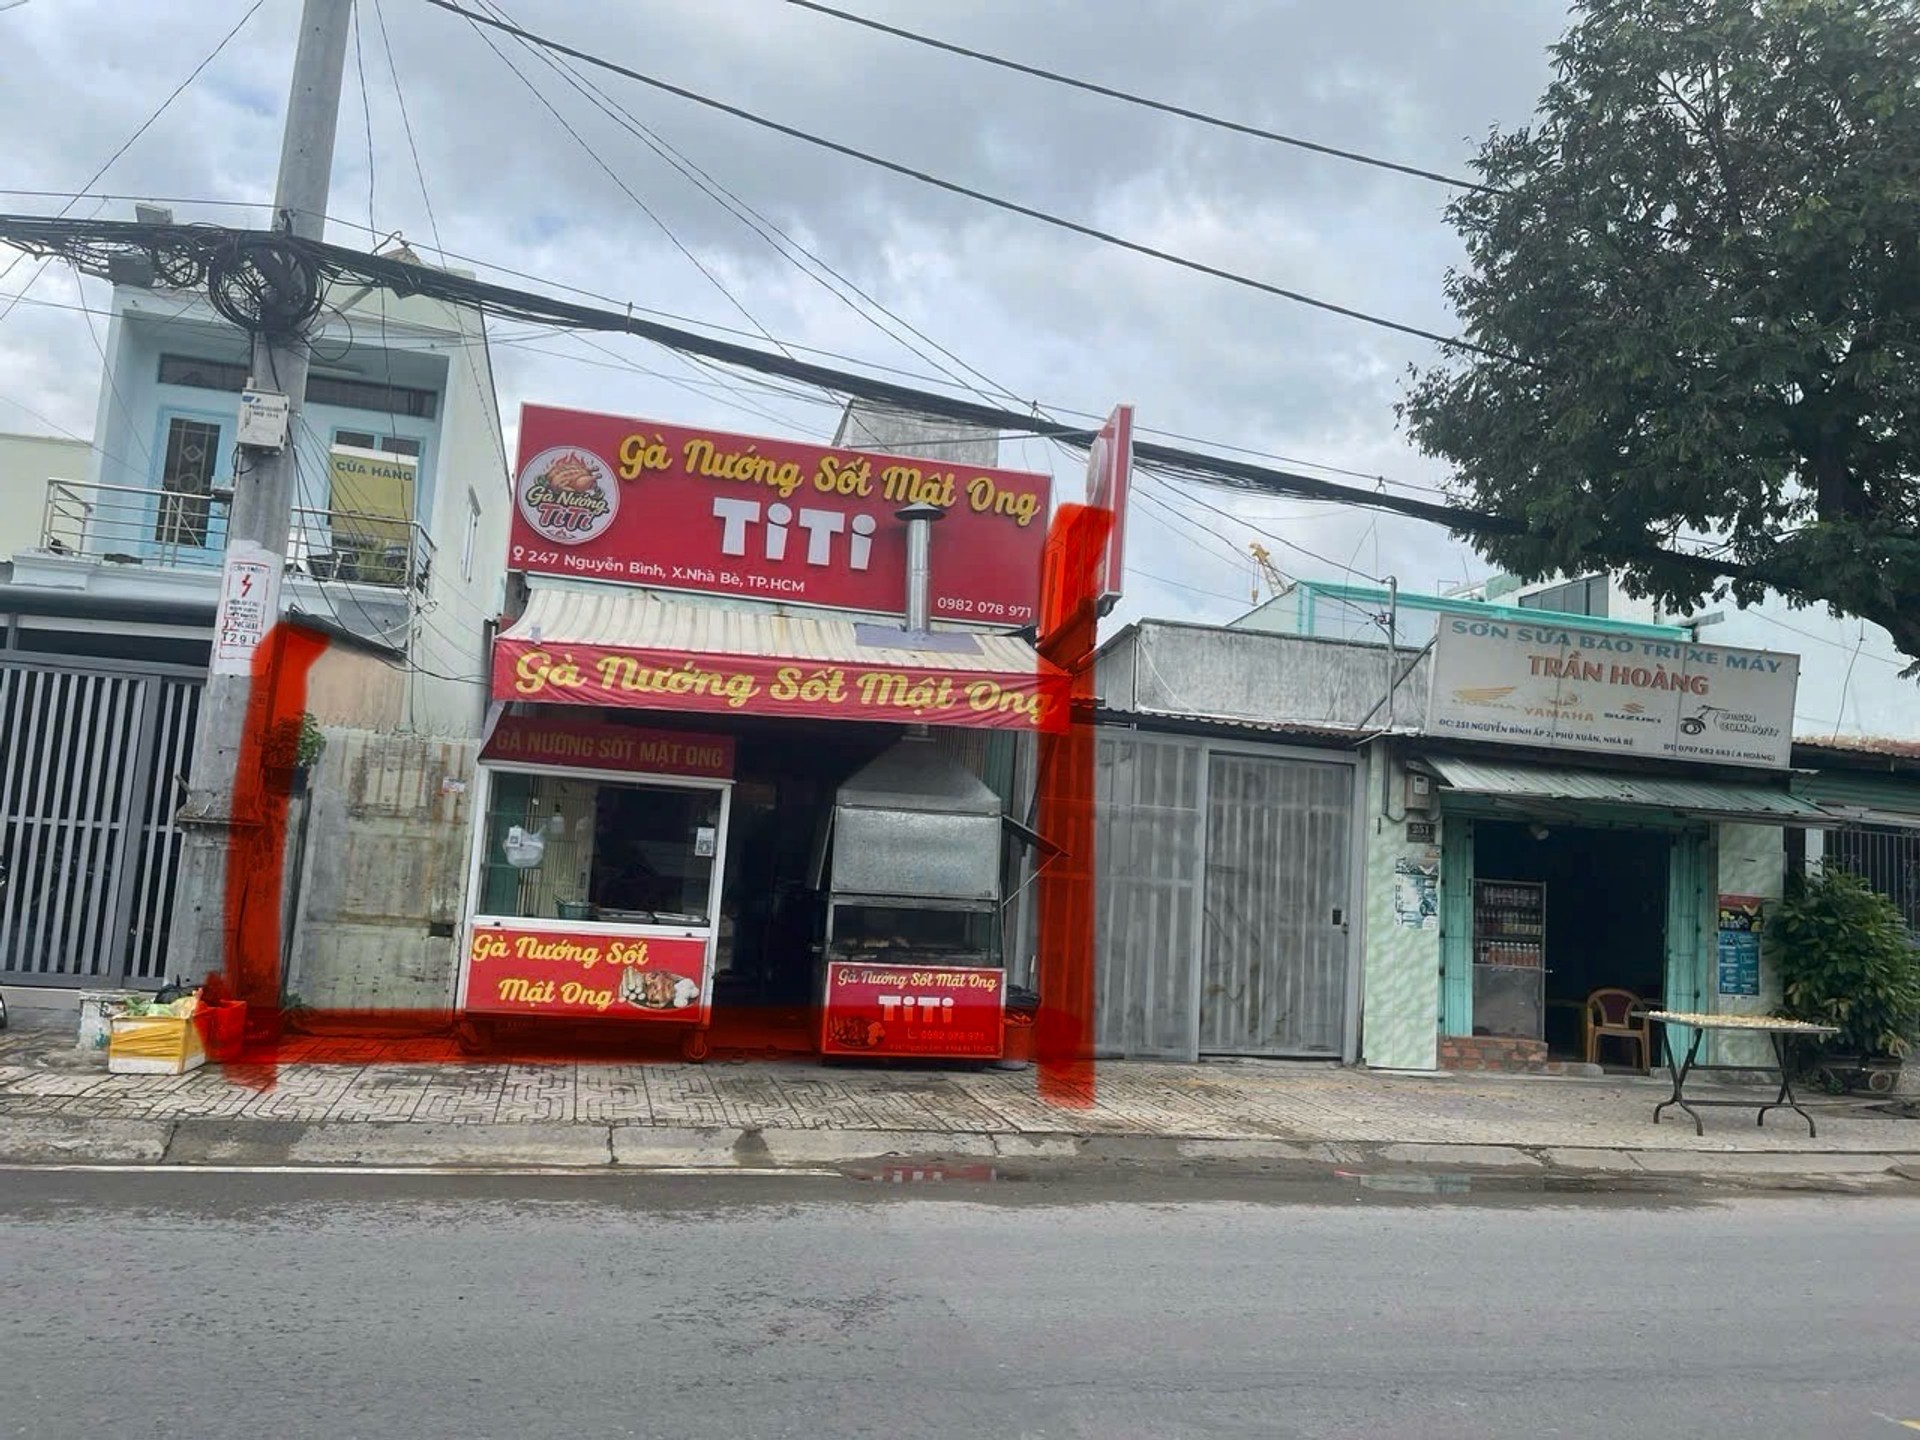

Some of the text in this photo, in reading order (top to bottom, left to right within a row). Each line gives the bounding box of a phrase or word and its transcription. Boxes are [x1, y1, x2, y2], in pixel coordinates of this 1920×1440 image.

[336, 459, 366, 474] CỬA
[619, 434, 673, 480] Gà
[683, 439, 805, 498] Nướng
[814, 455, 873, 497] Sốt
[966, 476, 1041, 527] Ong
[527, 485, 609, 516] Gà Nướng
[539, 502, 593, 531] TiTi
[713, 497, 876, 570] TiTi
[527, 550, 805, 592] 247 Nguyễn Bình, X.Nhà Bè, TP.HCM
[937, 597, 1032, 618] 0982 078 971
[1452, 620, 1509, 639] SƠN
[1686, 648, 1718, 665] XE
[1725, 653, 1782, 673] MÁY
[515, 651, 1059, 724] Gà Nướng Sốt Mật Ong
[1609, 664, 1710, 696] HOÀNG
[1523, 706, 1594, 721] YAMAHA
[1604, 712, 1661, 723] SUZUKI
[686, 746, 723, 768] ONG
[472, 934, 649, 969] Gà Nướng Sốt
[498, 978, 614, 1011] Mật Ong
[838, 968, 997, 992] Gà Nướng Sốt Mật Ong
[878, 995, 955, 1023] TiTi
